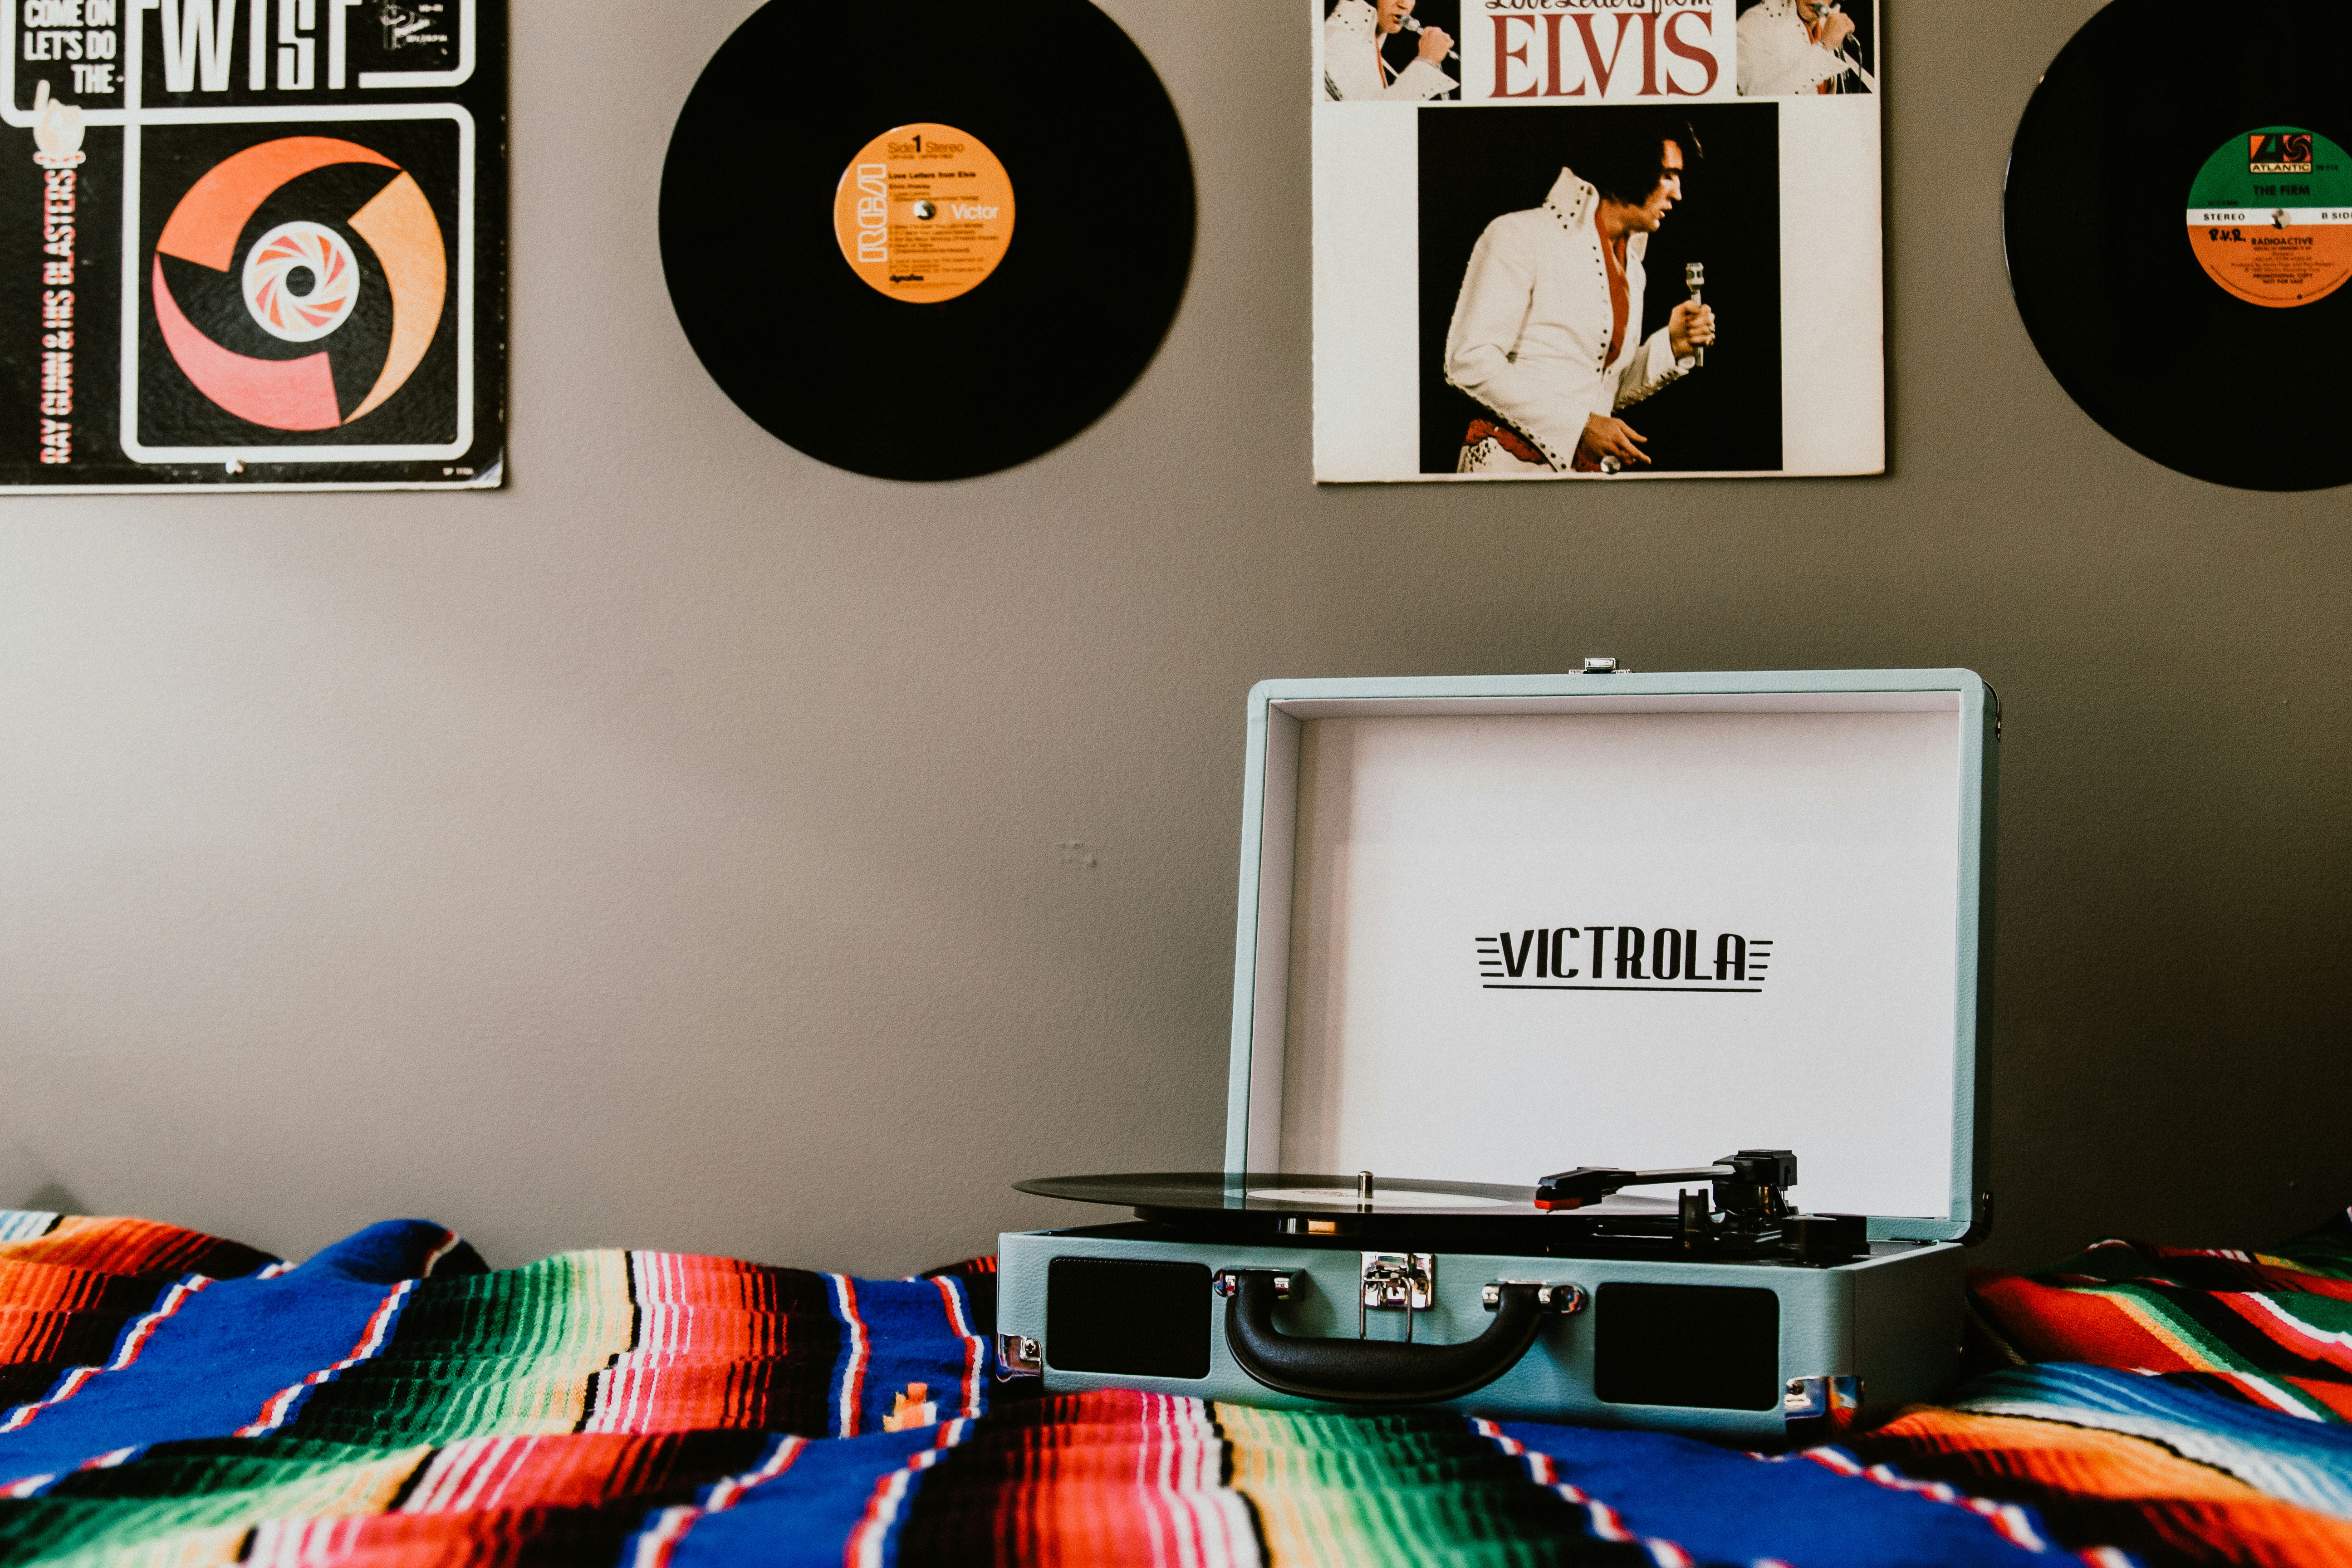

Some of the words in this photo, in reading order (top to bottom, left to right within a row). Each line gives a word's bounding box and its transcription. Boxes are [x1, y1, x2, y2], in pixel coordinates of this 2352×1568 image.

[24, 0, 84, 27] COME
[85, 0, 116, 27] ON
[24, 30, 83, 60] LET'S
[86, 30, 116, 59] DO
[1488, 10, 1720, 98] ELVIS
[912, 135, 921, 152] 1
[926, 141, 965, 153] Stereo
[2252, 164, 2310, 172] ATLANTIC
[2253, 185, 2276, 196] THE
[2280, 185, 2310, 196] FIRM
[858, 164, 887, 263] RCA
[952, 203, 999, 220] Victor
[43, 169, 77, 285] BLASTERS
[2251, 237, 2313, 245] RADIOACTIVE
[43, 289, 75, 328] HIS
[42, 331, 74, 349] &
[41, 352, 74, 415] GUNN
[40, 418, 73, 464] RAY
[1500, 926, 1746, 981] VICTROLA
